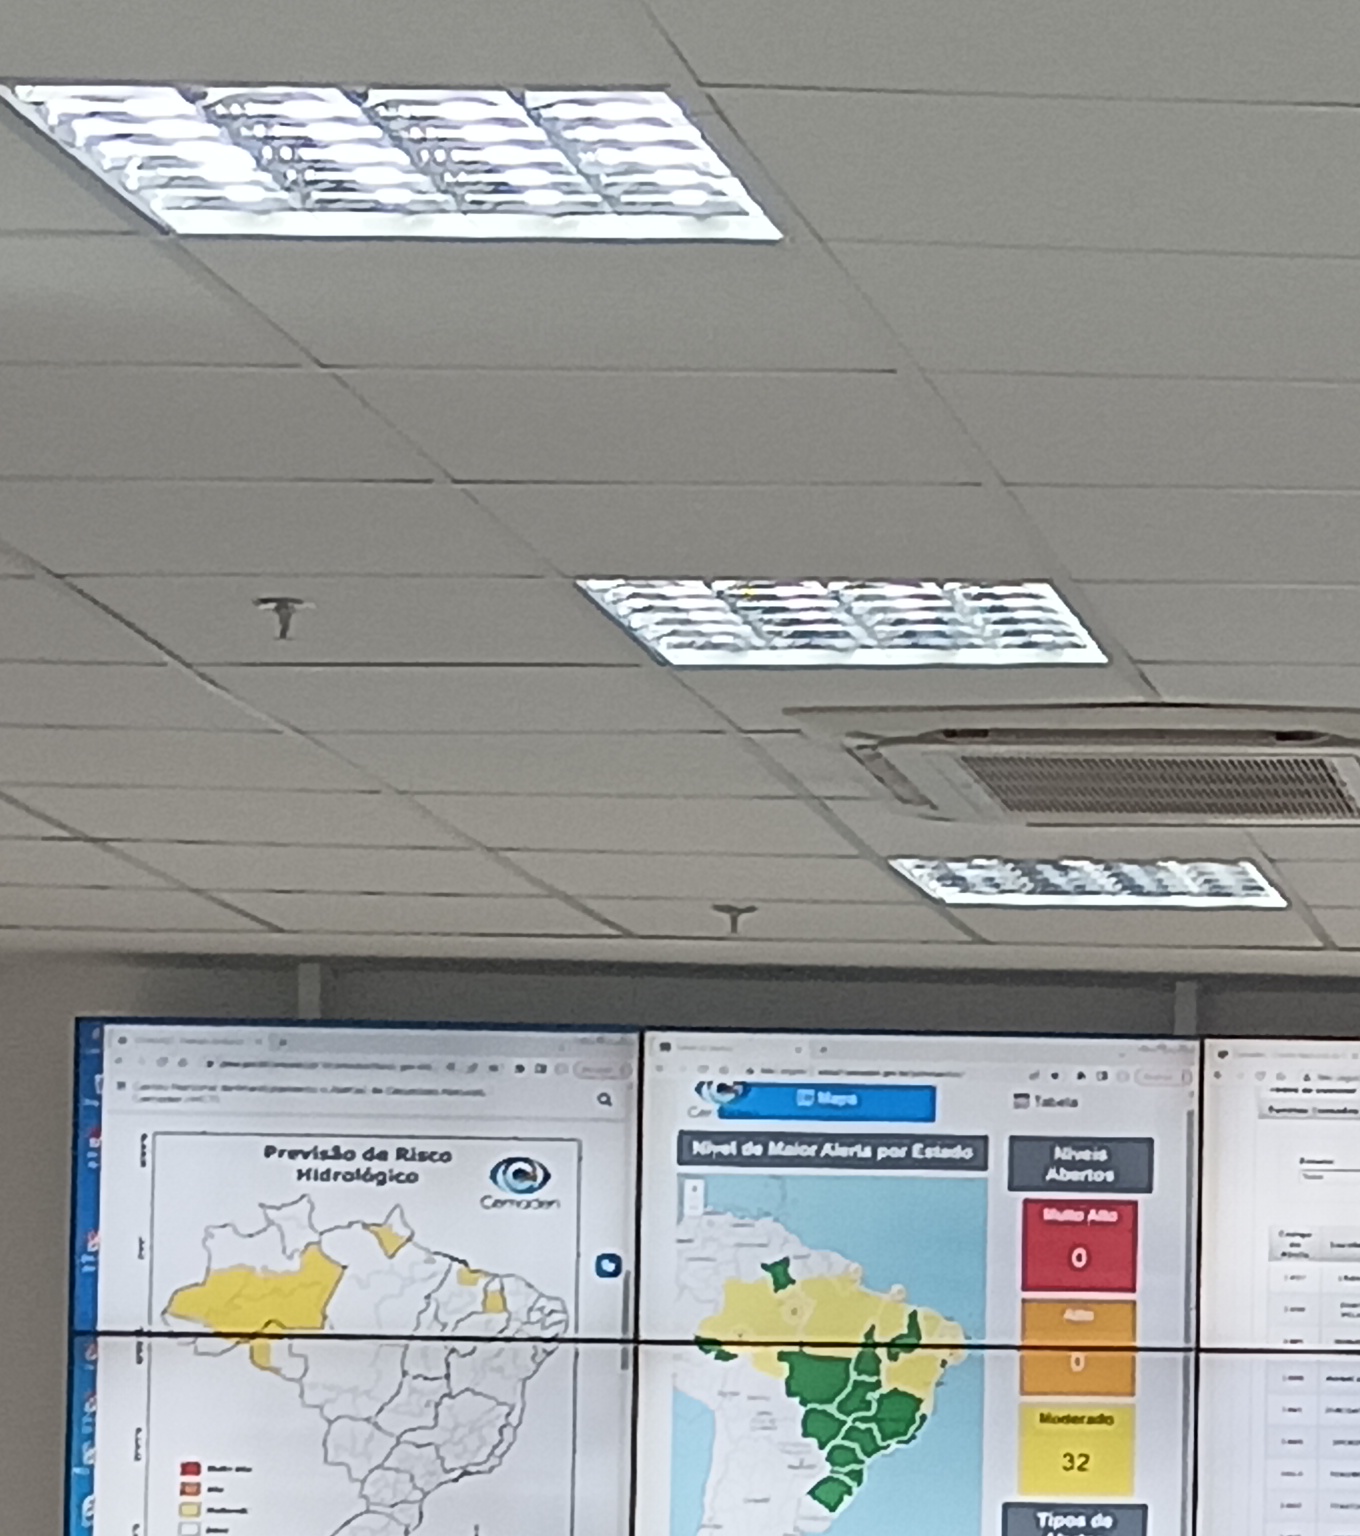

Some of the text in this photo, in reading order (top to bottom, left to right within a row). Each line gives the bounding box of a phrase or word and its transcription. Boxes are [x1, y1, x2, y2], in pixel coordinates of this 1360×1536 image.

[263, 1144, 453, 1163] Previsão de Risco
[742, 1141, 763, 1157] de
[877, 1145, 908, 1161] por
[912, 1143, 974, 1160] Estado
[296, 1167, 420, 1187] Hidrológico
[1071, 1247, 1087, 1268] 0
[1070, 1351, 1085, 1372] 0
[1038, 1412, 1115, 1426] Moderado
[1062, 1452, 1091, 1472] 32
[1036, 1511, 1114, 1530] Tipos de
